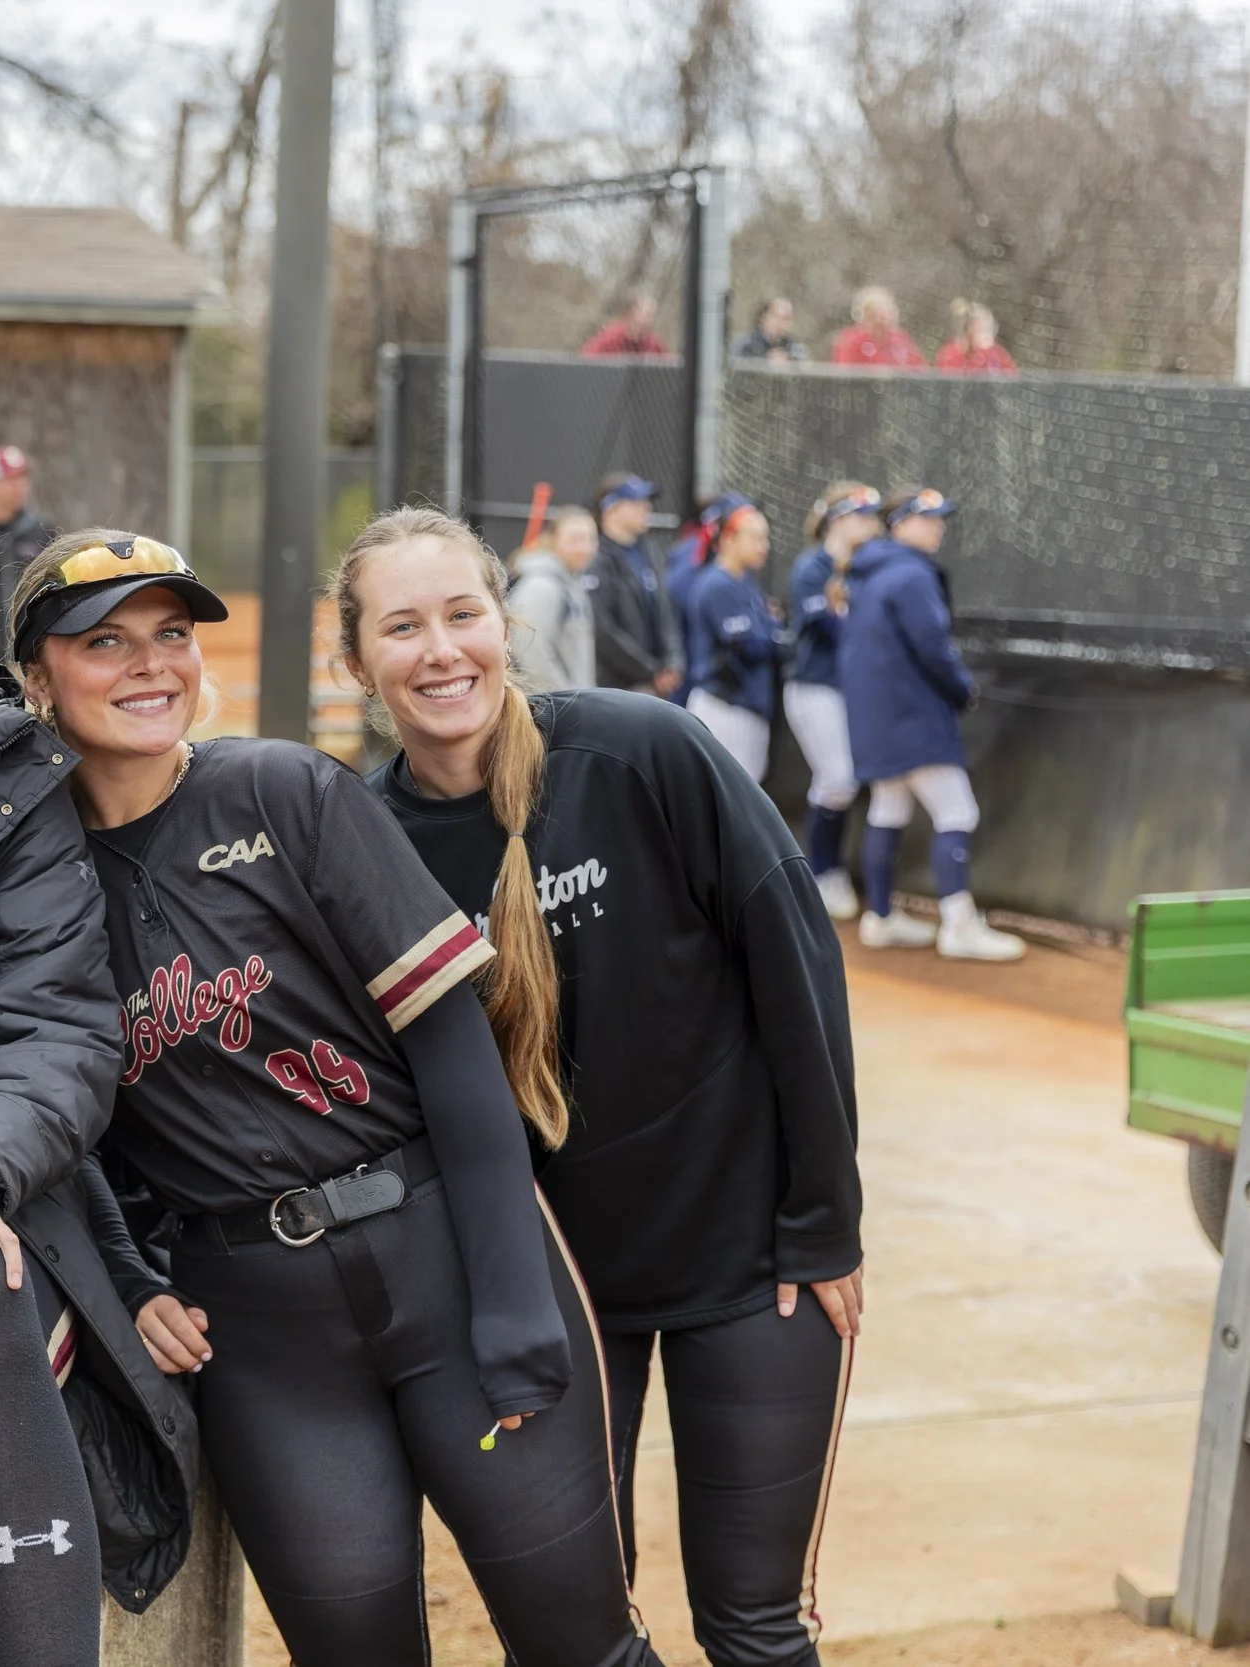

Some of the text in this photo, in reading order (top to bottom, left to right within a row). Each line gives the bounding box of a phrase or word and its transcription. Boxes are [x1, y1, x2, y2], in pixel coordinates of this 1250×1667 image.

[198, 831, 276, 873] CAA
[551, 902, 604, 937] ALL
[118, 953, 273, 1086] ollege
[127, 988, 151, 1018] The
[265, 1039, 370, 1116] 99
